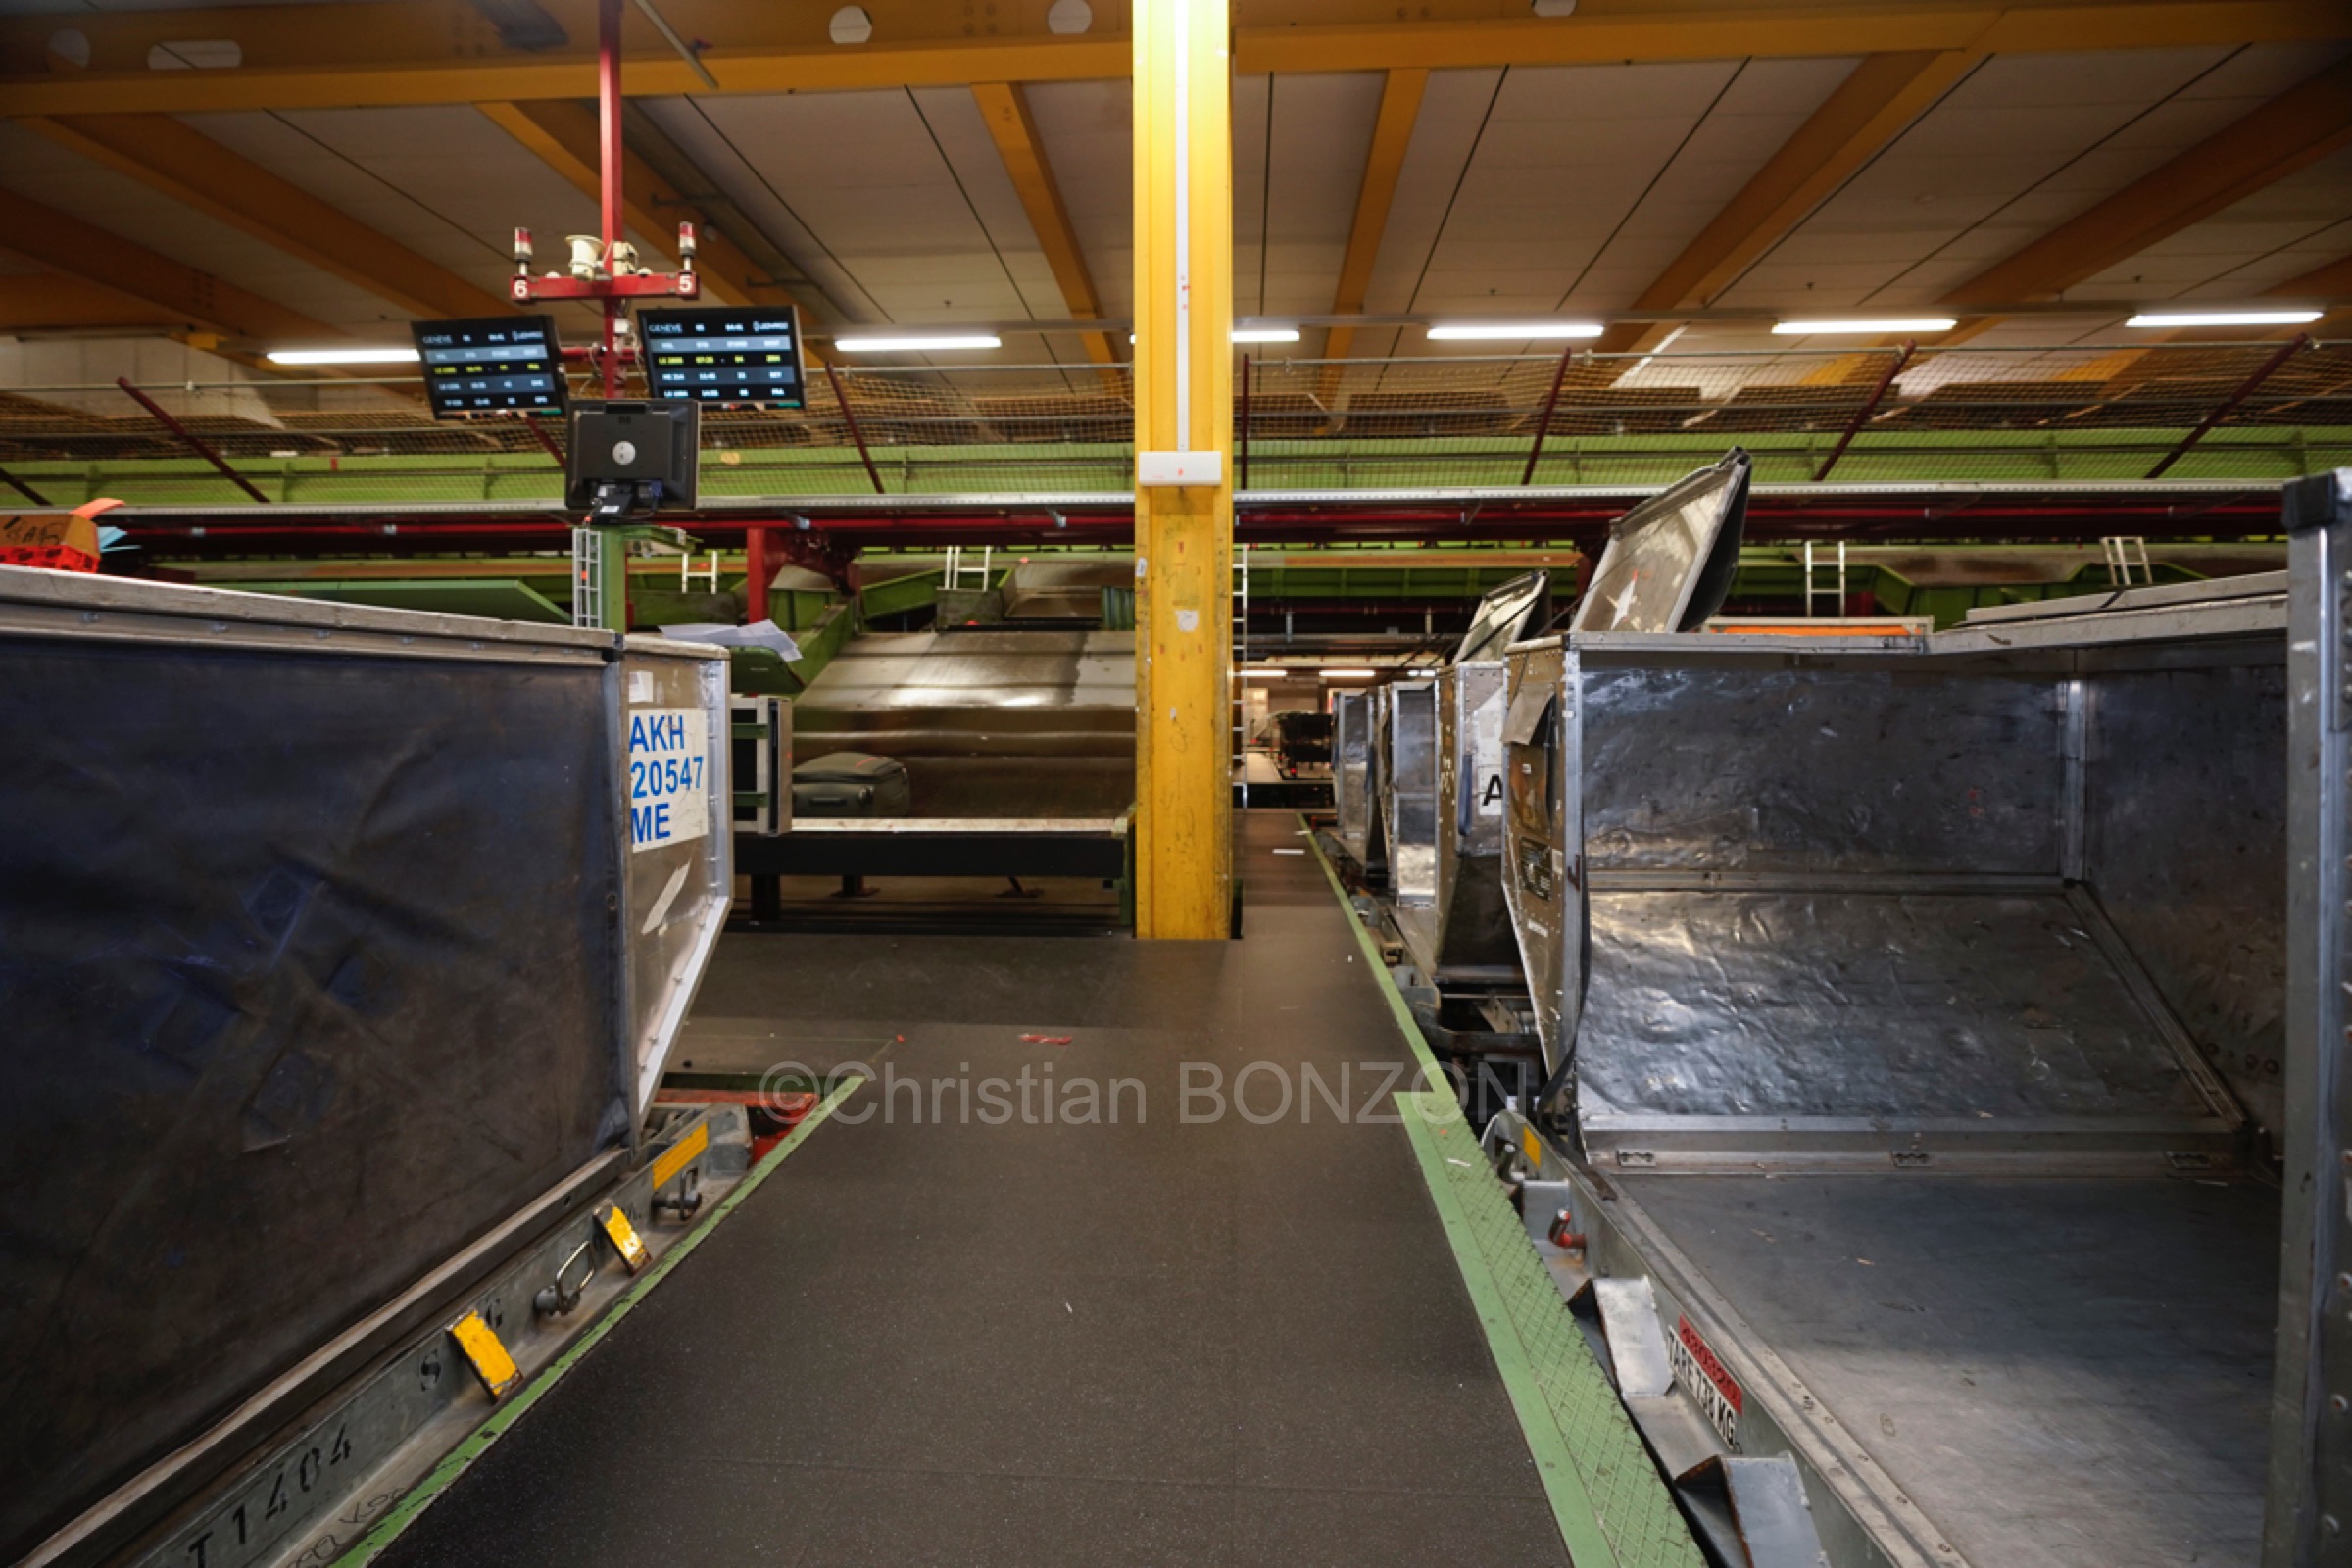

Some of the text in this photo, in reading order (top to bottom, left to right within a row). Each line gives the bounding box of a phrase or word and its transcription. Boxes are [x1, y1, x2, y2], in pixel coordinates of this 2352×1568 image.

[513, 279, 528, 298] 6
[678, 274, 693, 293] 5
[628, 714, 685, 754] AKH
[630, 756, 705, 799] 20547
[1483, 773, 1502, 807] A
[630, 802, 671, 844] ME
[1668, 1329, 1693, 1391] TARE
[1718, 1396, 1734, 1446] KG
